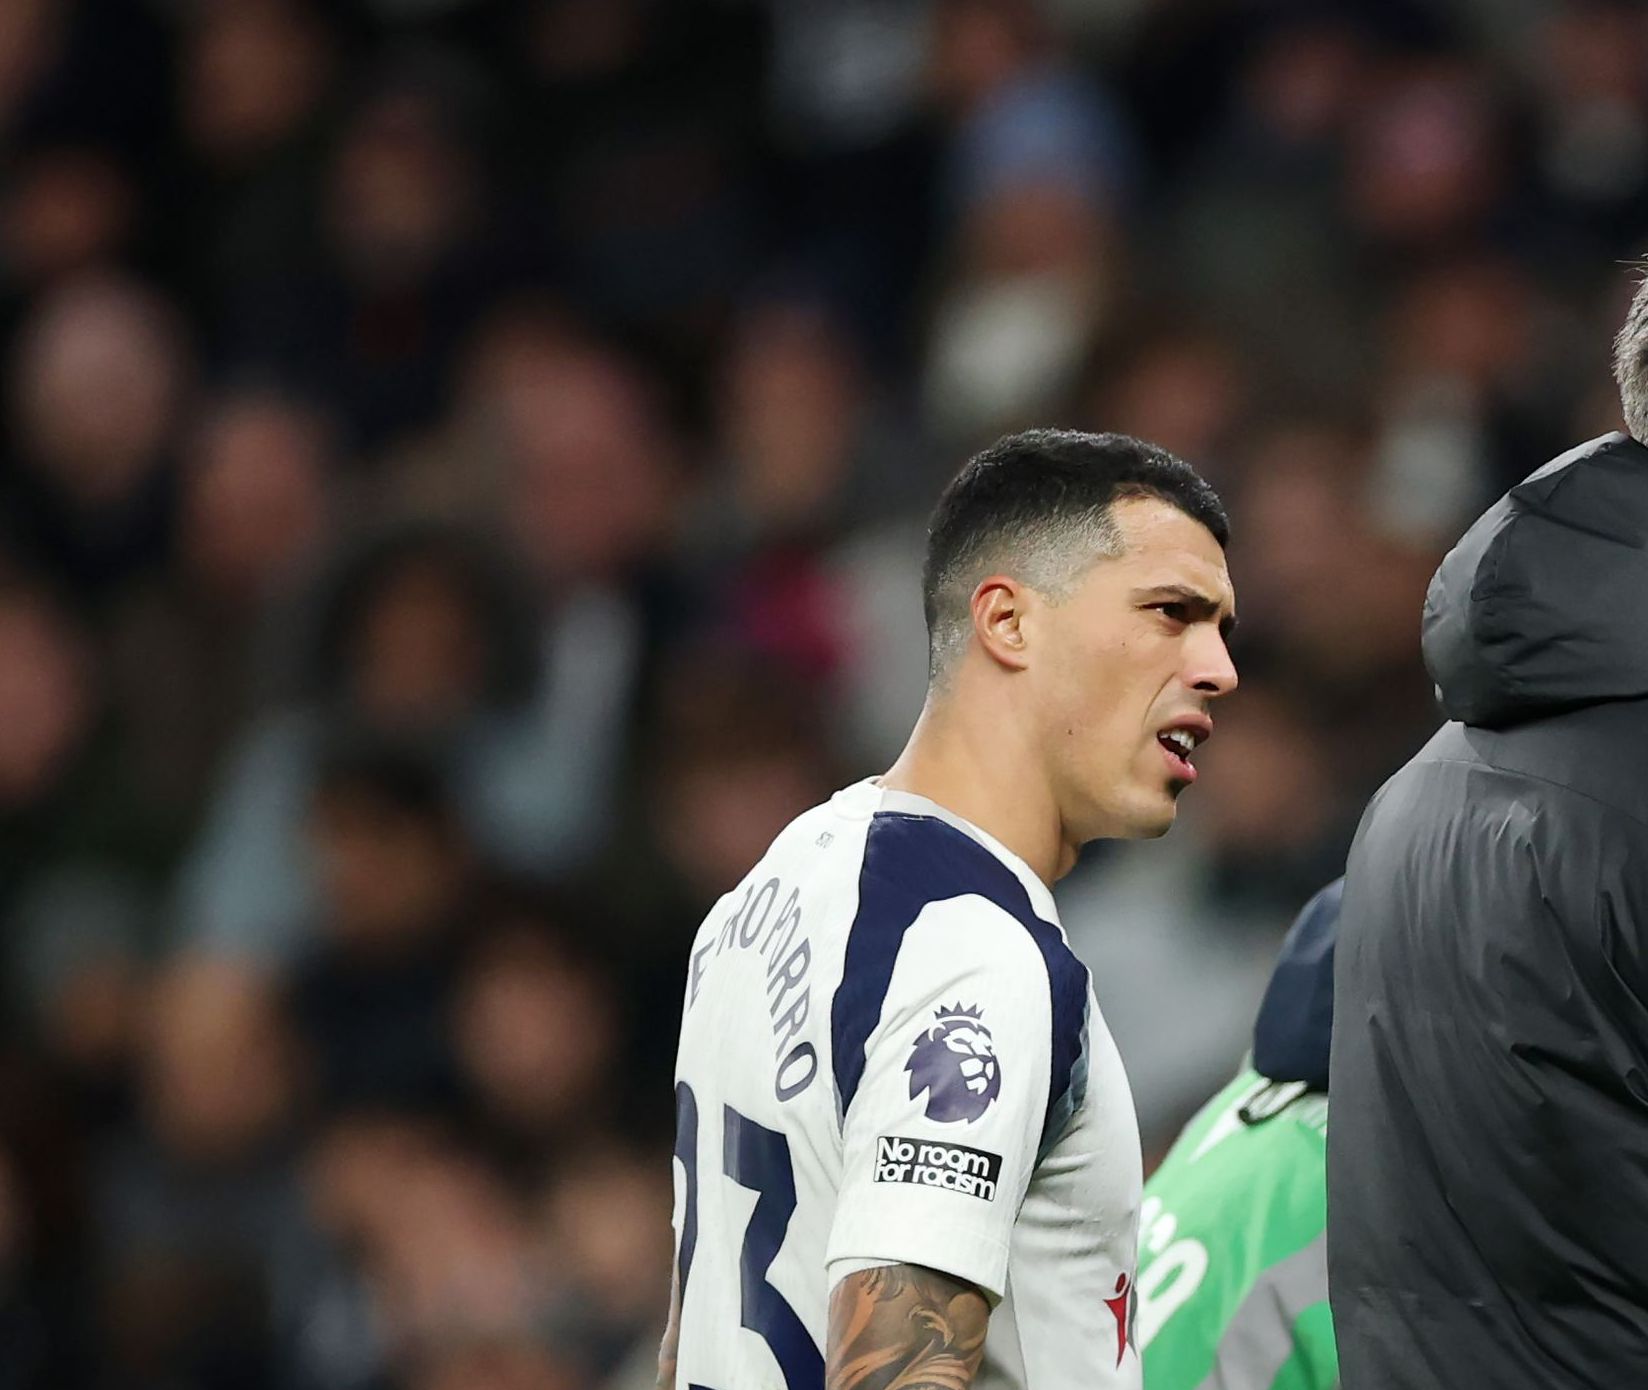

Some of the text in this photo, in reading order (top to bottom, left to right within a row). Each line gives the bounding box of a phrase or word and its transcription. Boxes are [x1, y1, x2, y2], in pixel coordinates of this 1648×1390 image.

[878, 1136, 991, 1177] No room
[873, 1158, 996, 1201] for racism
